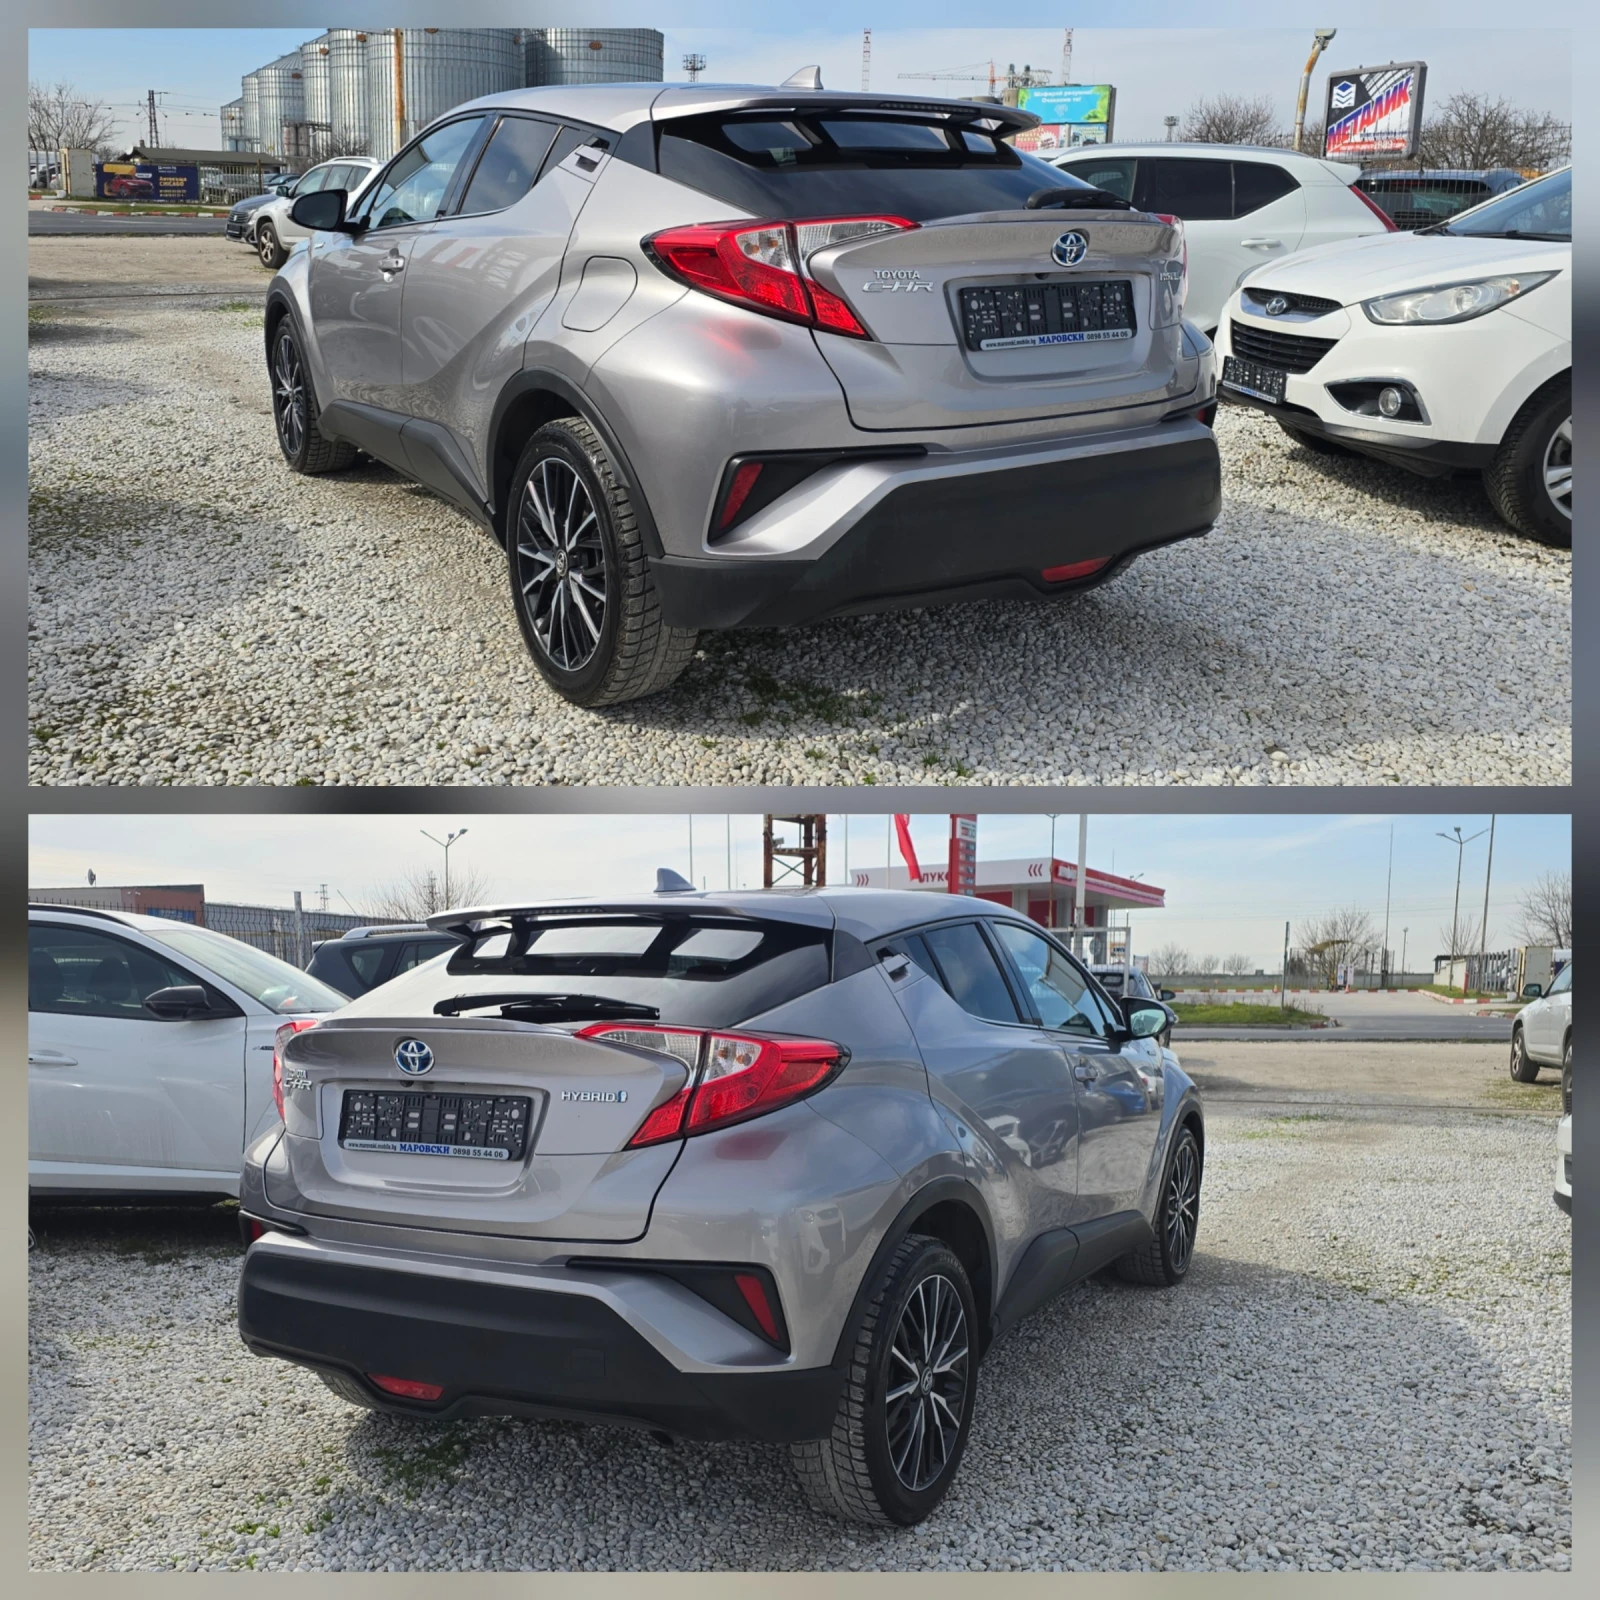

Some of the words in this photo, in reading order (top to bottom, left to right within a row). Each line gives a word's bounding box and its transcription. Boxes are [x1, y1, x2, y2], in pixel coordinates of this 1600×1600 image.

[1327, 75, 1411, 152] МЕТАЛИК
[873, 269, 921, 280] TOYOTA
[862, 280, 935, 293] C-HR
[1038, 332, 1085, 345] МАРОВСКИ
[1086, 332, 1102, 341] 0898
[1120, 330, 1129, 338] 06
[561, 1090, 617, 1103] HYBRID
[399, 1142, 450, 1155] МАРОВСКИ
[452, 1147, 471, 1156] 0898
[472, 1149, 482, 1157] 55
[483, 1150, 493, 1158] 44
[494, 1151, 504, 1159] 06
